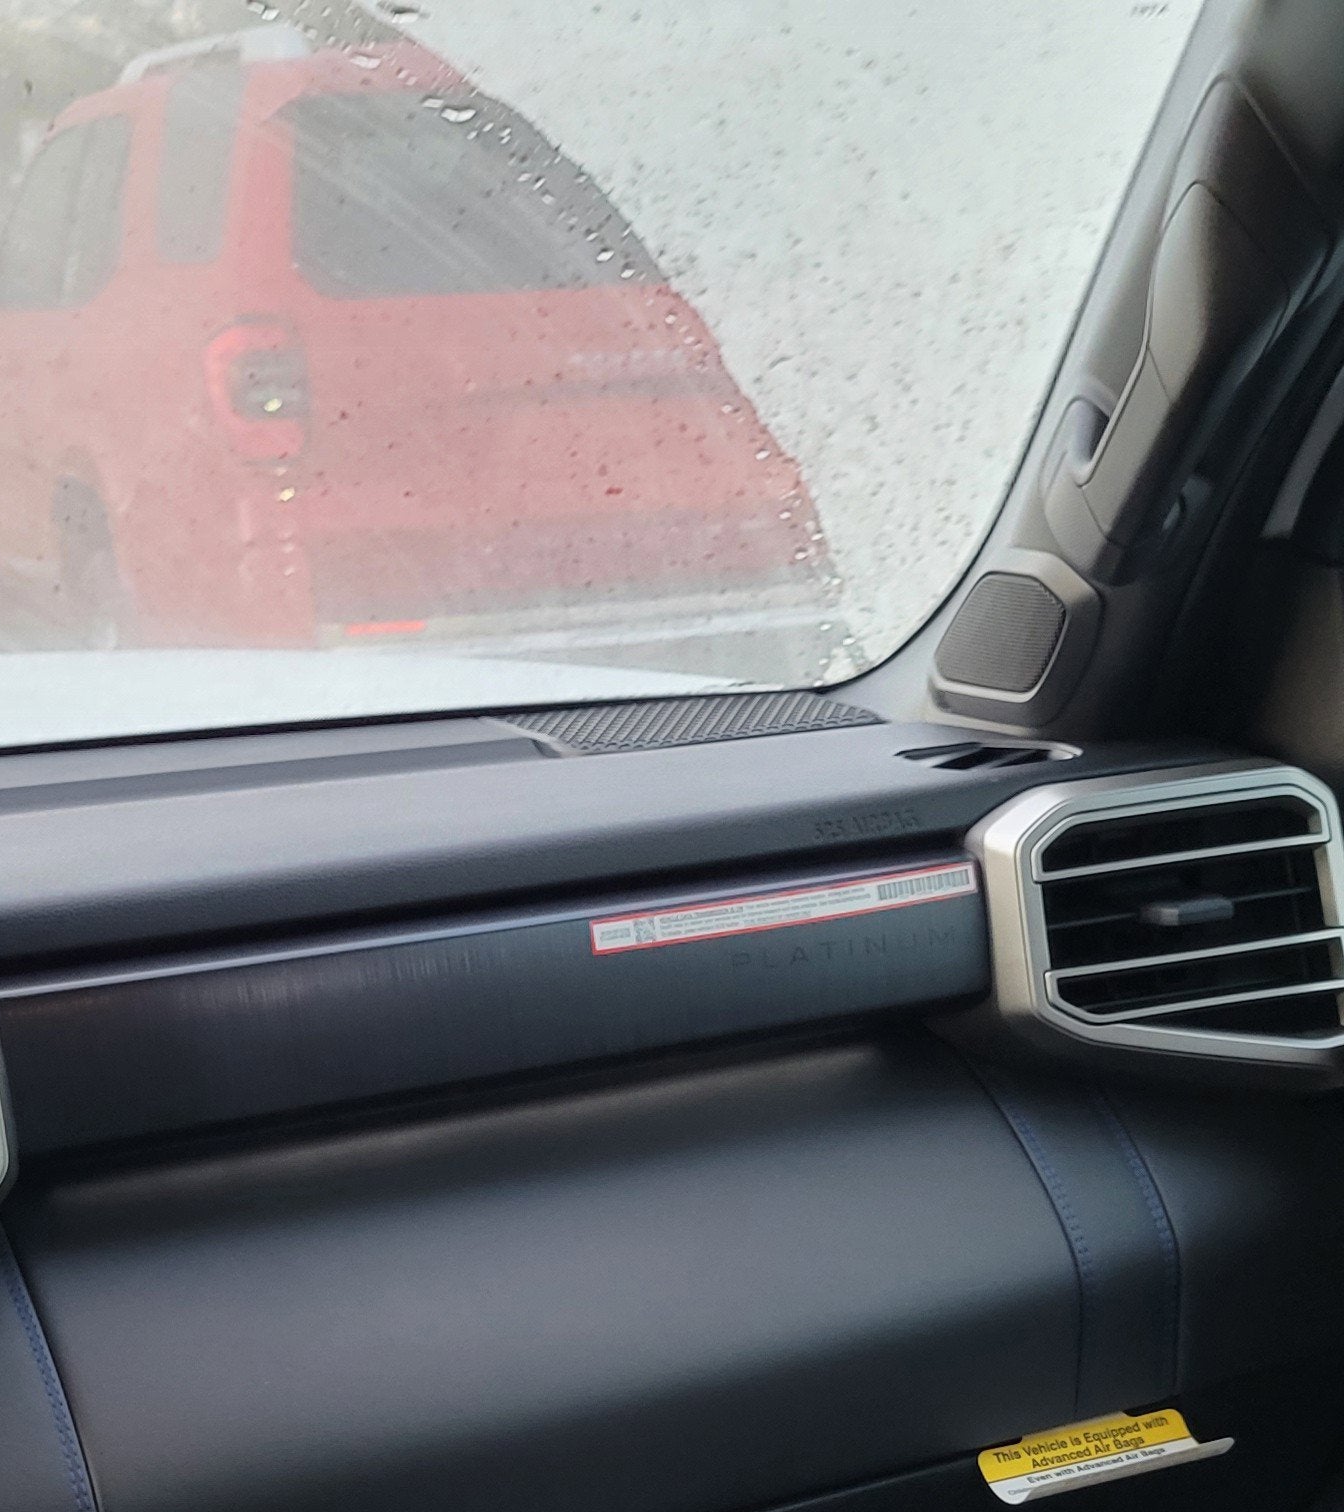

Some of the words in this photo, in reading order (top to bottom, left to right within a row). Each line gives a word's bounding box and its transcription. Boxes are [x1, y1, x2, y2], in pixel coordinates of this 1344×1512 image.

[993, 1450, 1021, 1464] This
[1022, 1439, 1068, 1457] Vehicle
[1069, 1435, 1081, 1447] is
[1083, 1421, 1141, 1443] Equipped
[1142, 1415, 1169, 1429] with
[1032, 1446, 1092, 1469] Advanced
[1094, 1440, 1112, 1457] Air
[1113, 1435, 1145, 1450] Bags
[1027, 1472, 1053, 1485] Even
[1056, 1466, 1075, 1478] with
[1076, 1456, 1123, 1473] Advanced
[1124, 1451, 1139, 1461] Air
[1140, 1446, 1166, 1459] Bags
